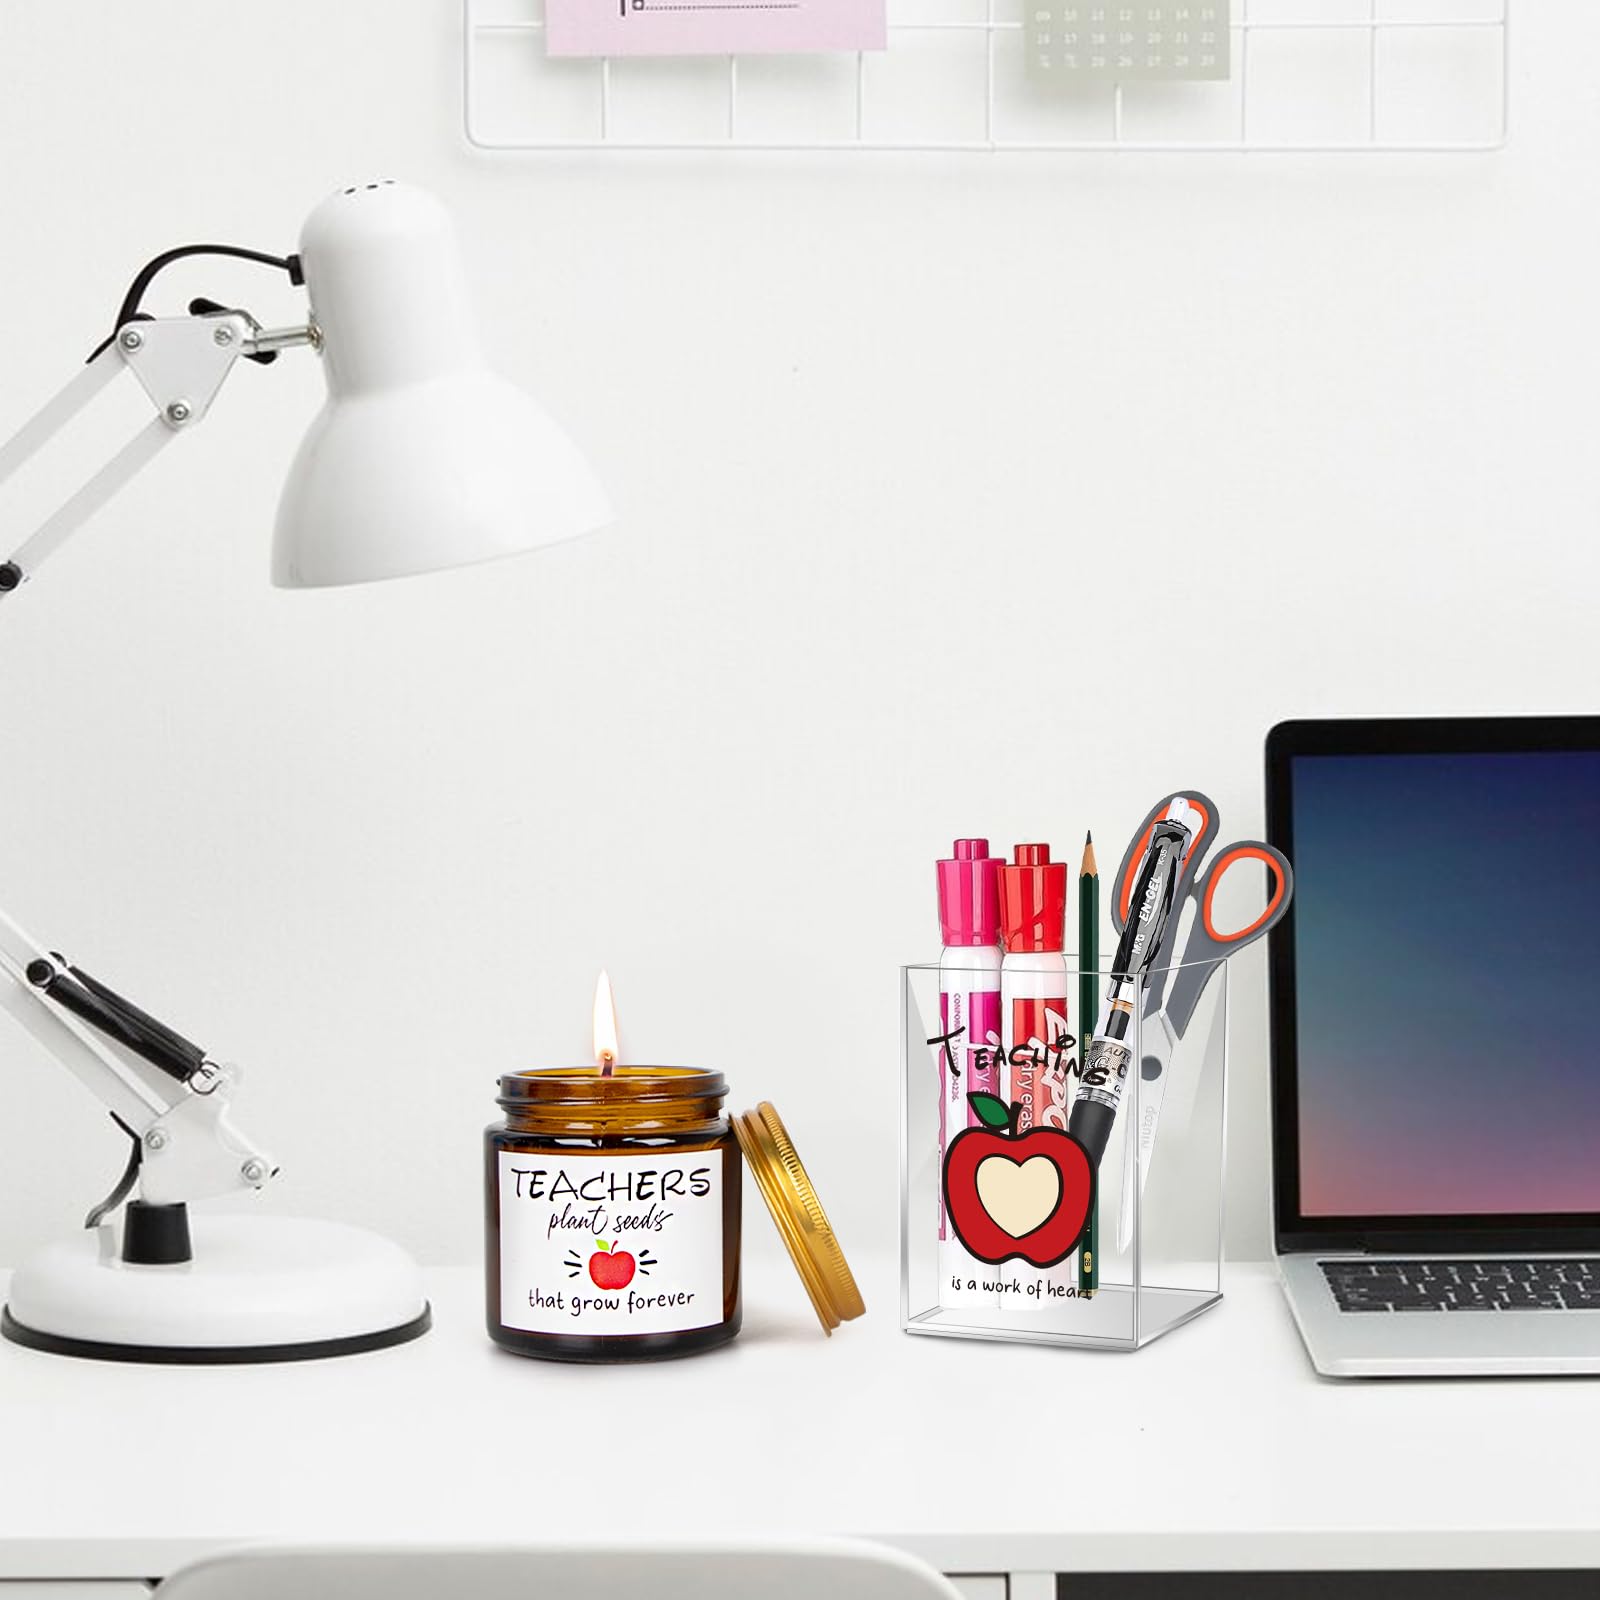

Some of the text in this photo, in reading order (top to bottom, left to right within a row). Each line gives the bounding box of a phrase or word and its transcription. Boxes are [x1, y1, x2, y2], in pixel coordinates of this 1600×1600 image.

[1139, 876, 1162, 923] EN-GEL
[1021, 1094, 1033, 1133] eras
[511, 1168, 710, 1201] TEACHERS
[548, 1203, 674, 1240] plant seeds
[529, 1288, 695, 1316] that grow forever
[952, 1276, 961, 1291] is
[967, 1280, 976, 1290] a
[982, 1278, 1021, 1293] work
[1027, 1280, 1042, 1299] of
